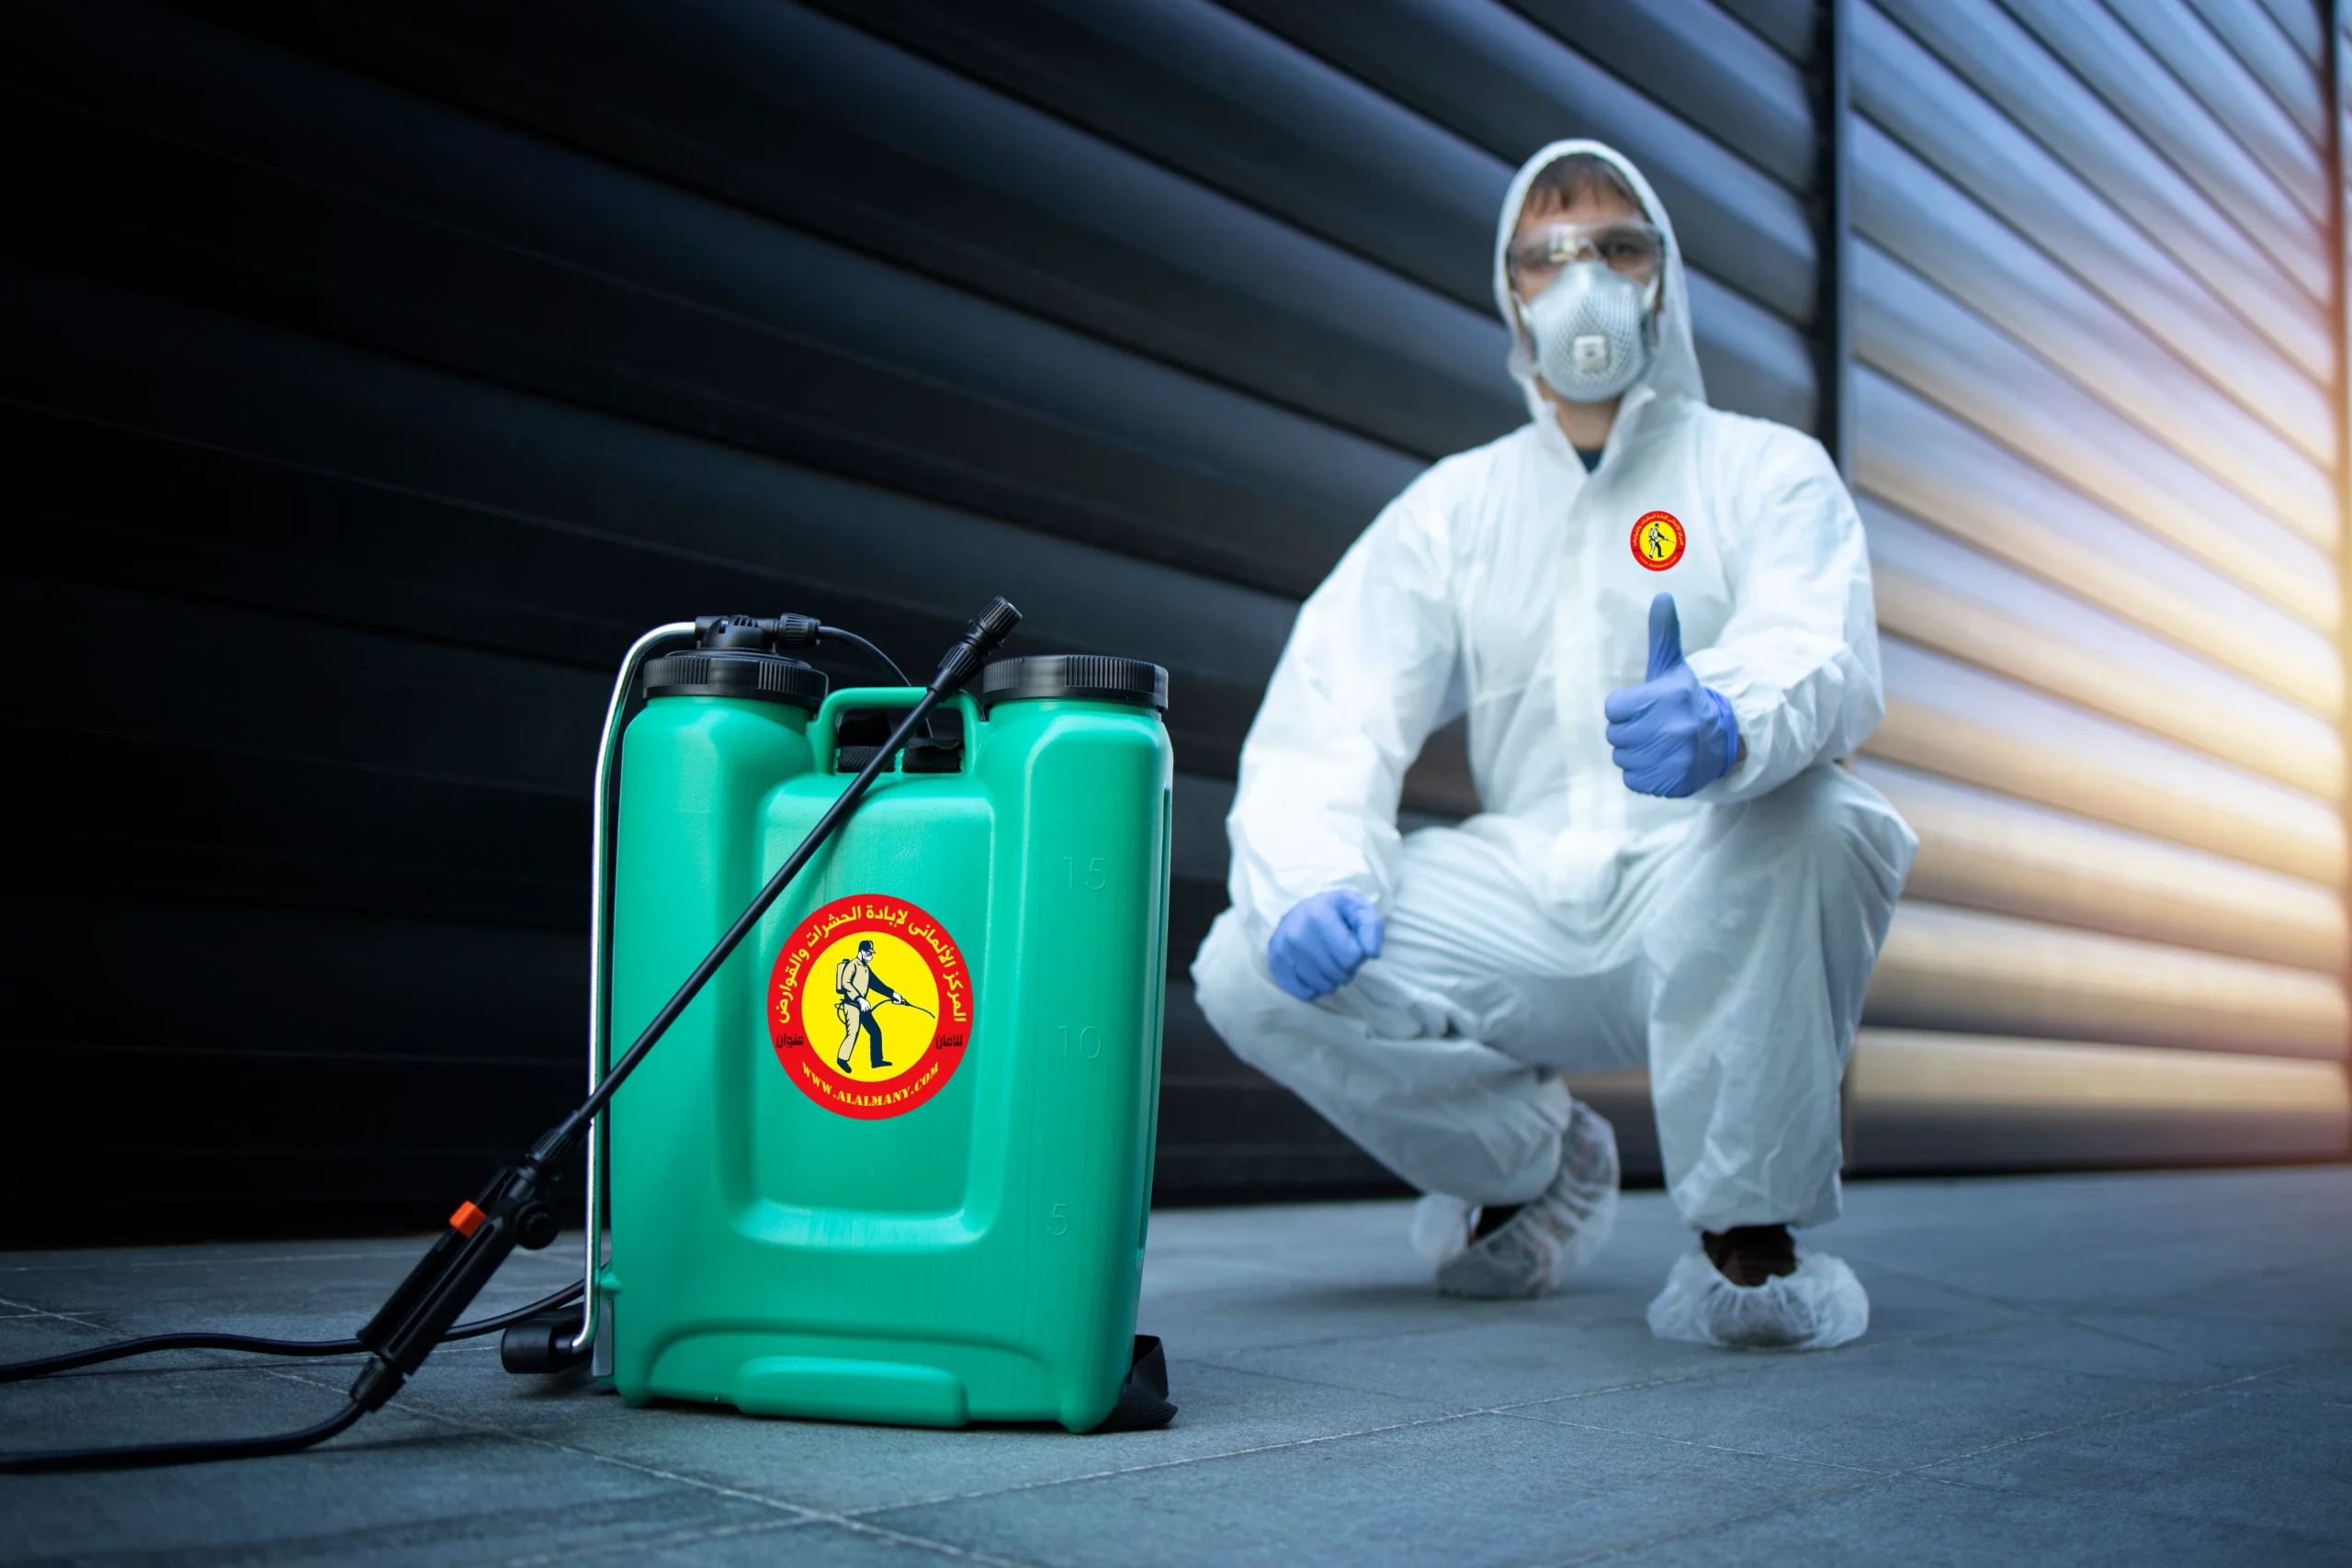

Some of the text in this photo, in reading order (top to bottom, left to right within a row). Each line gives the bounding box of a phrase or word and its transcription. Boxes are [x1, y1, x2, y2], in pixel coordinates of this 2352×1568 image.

[1064, 857, 1107, 892] 15
[807, 905, 862, 948] الحشرات
[865, 905, 908, 928] لإبادة
[775, 948, 810, 1024] والقوارض
[943, 971, 967, 1022] المركز
[1057, 1025, 1102, 1060] 10
[802, 1061, 939, 1107] WWW.ALALMANY.COM
[1047, 1203, 1069, 1237] 5
